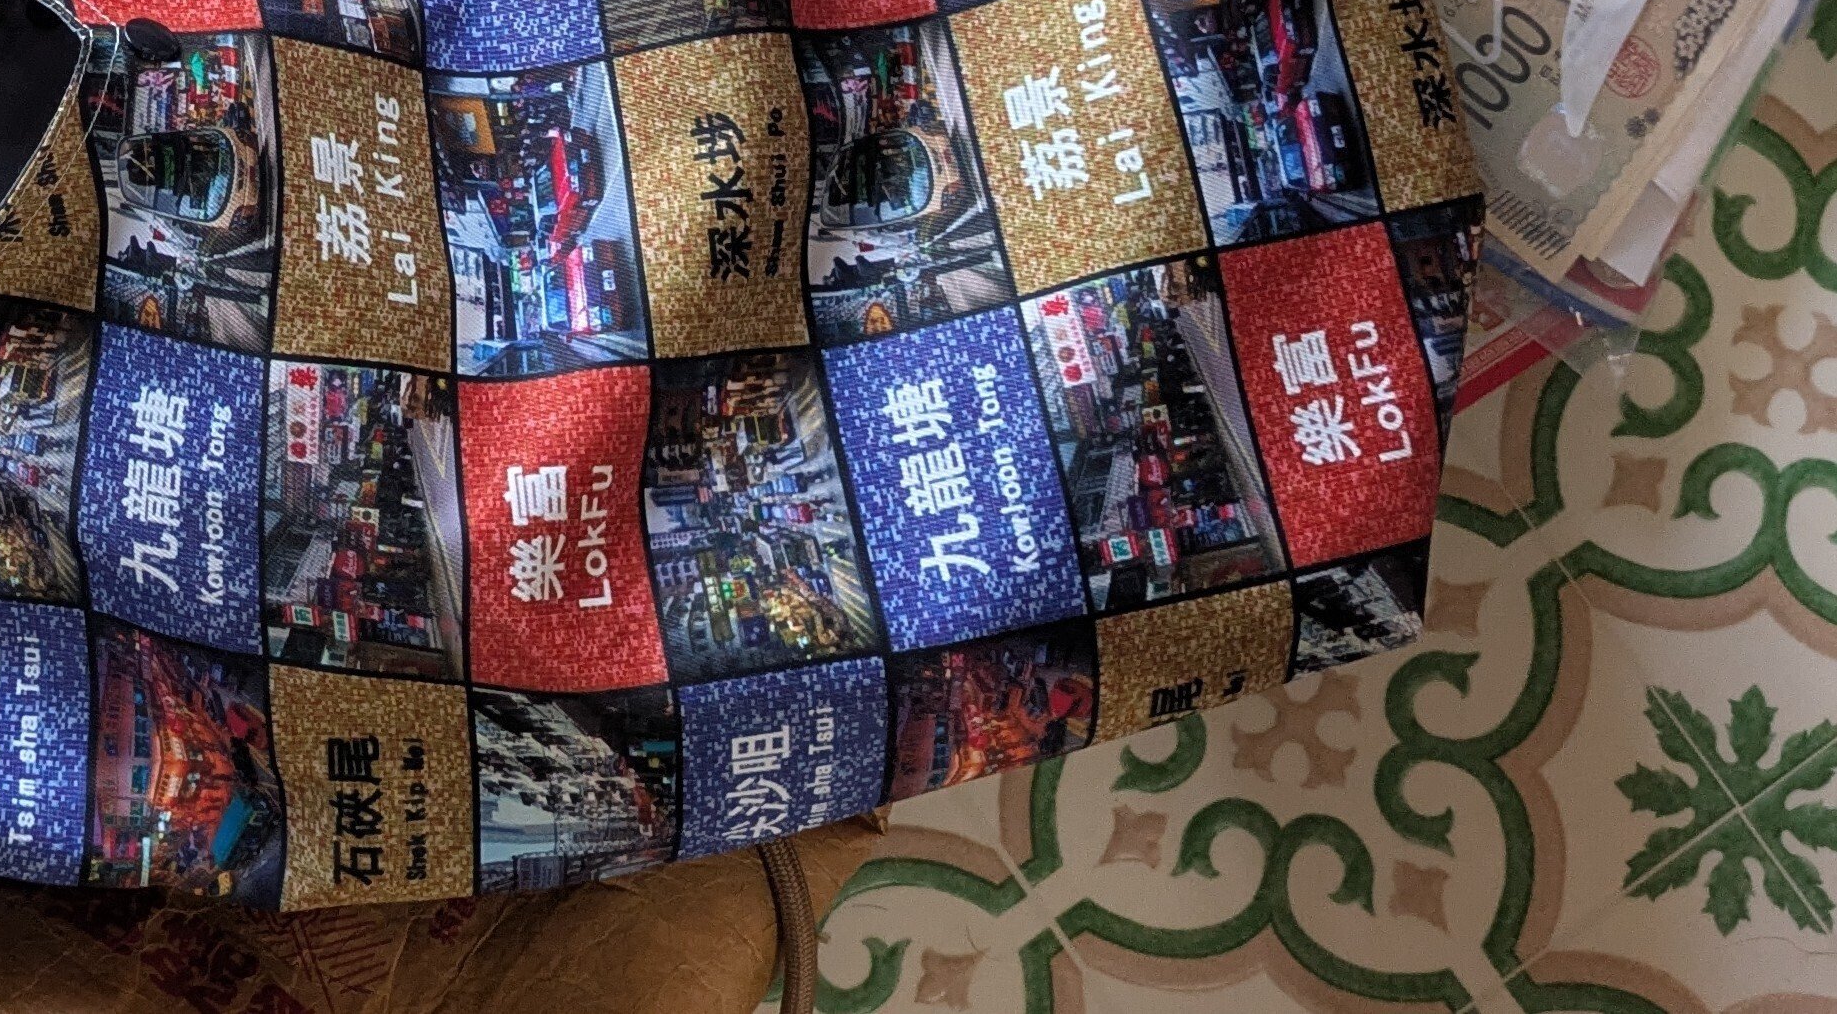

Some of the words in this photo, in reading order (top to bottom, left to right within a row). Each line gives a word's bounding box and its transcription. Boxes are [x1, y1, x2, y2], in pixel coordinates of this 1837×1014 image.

[767, 107, 786, 136] Po
[1455, 5, 1552, 131] 1000
[374, 93, 402, 201] King
[1001, 65, 1092, 201] 荔景
[1096, 127, 1154, 208] Lai
[309, 132, 373, 267] 荔景
[691, 112, 754, 281] 深水埗
[374, 225, 419, 307] Lai
[201, 401, 235, 475] Tong
[971, 363, 1004, 434] Tong
[1271, 328, 1364, 468] 樂富
[1349, 319, 1415, 463] LokFu
[120, 383, 190, 594] 九龍塘
[504, 463, 568, 605] 樂富
[577, 463, 615, 610] LokFu
[882, 375, 991, 583] 九龍塘
[991, 446, 1042, 575] Kowloon
[197, 491, 228, 607] Kowloon
[14, 635, 41, 697] Tsui
[400, 737, 425, 771] Mei
[721, 724, 791, 841] 尖沙咀
[808, 706, 834, 756] Tsui
[7, 775, 37, 845] Tsim
[403, 777, 429, 819] Kip
[405, 829, 429, 881] Shek
